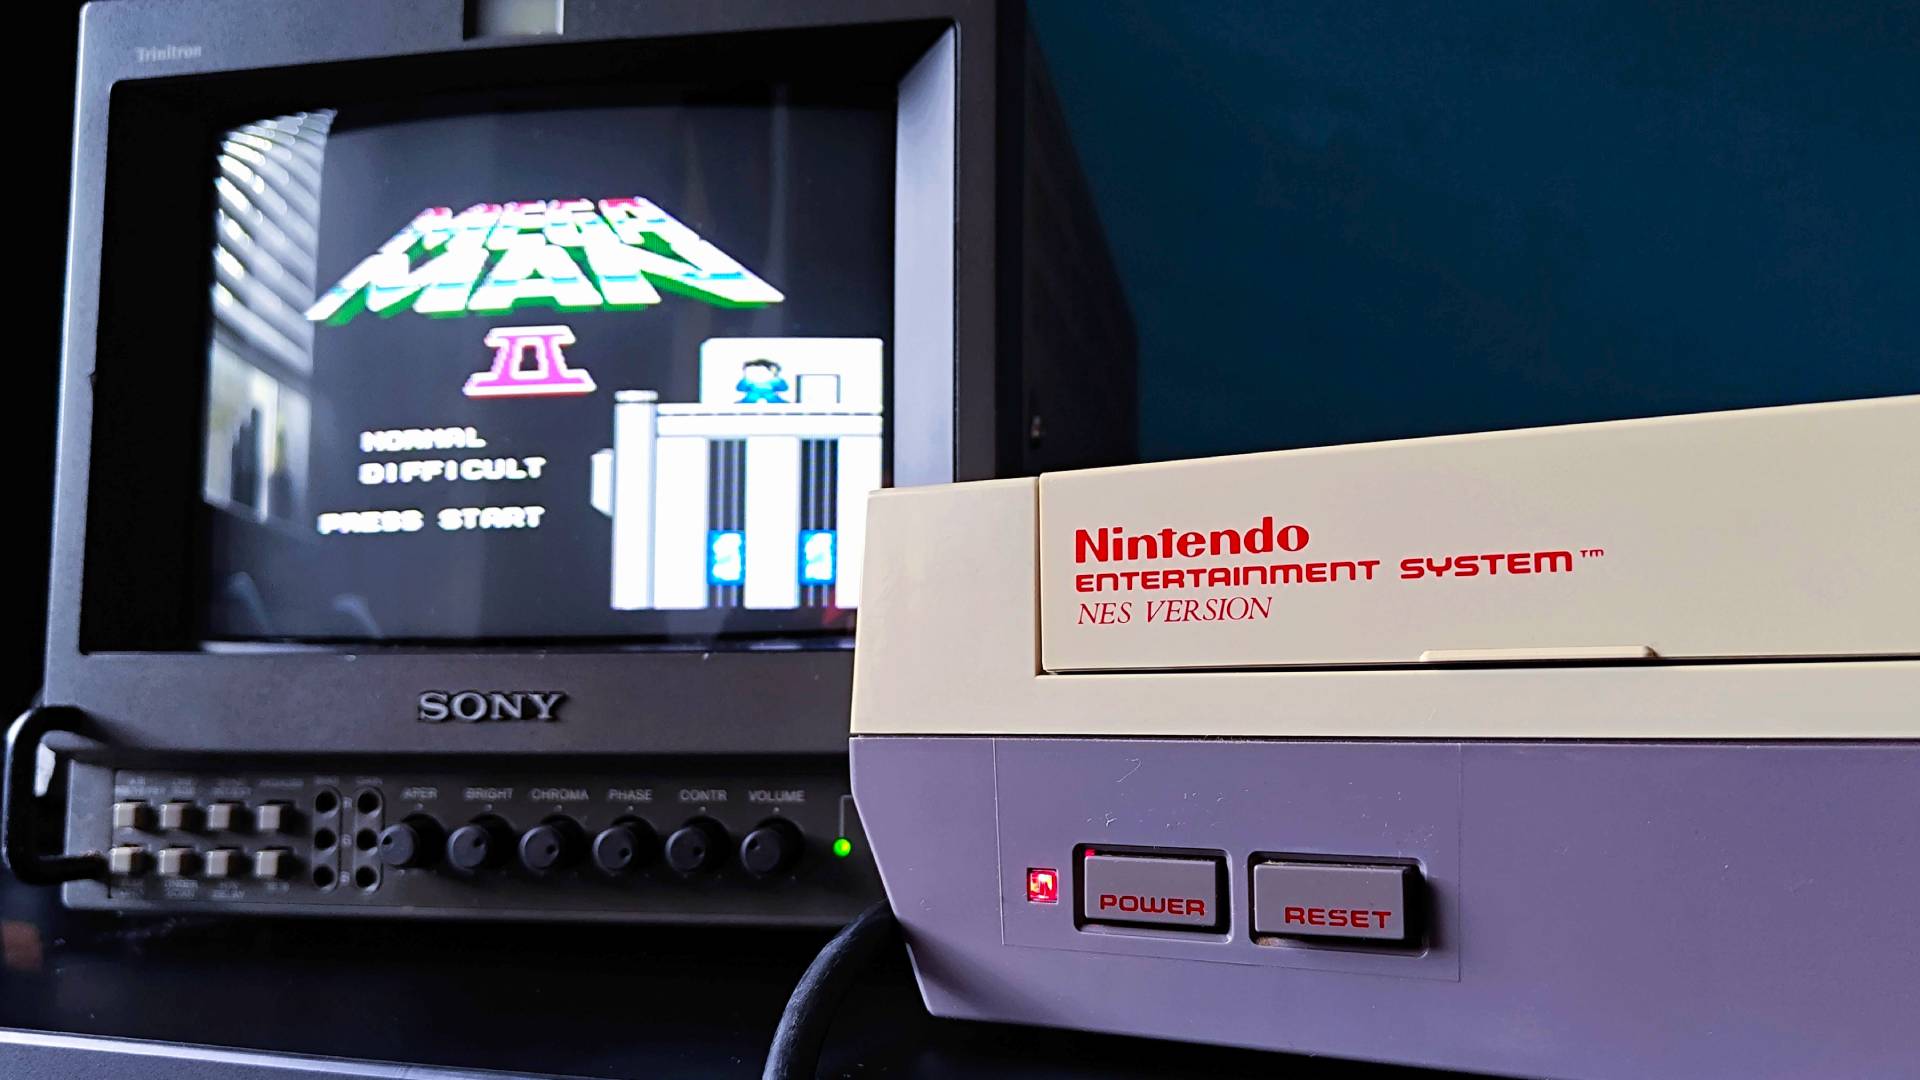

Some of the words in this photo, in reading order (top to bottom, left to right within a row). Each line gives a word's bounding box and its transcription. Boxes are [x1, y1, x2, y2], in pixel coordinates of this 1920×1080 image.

[135, 44, 202, 63] Trinitron
[303, 240, 787, 326] MAN
[360, 426, 487, 452] NORMAL
[358, 456, 547, 485] DIFFICULT
[317, 508, 425, 534] PRESS
[437, 504, 546, 530] START
[1074, 516, 1311, 563] Nintendo
[1075, 560, 1381, 592] ENTERTAINMENT
[1400, 549, 1574, 579] SYSTEM
[1077, 602, 1132, 625] NES
[1144, 596, 1273, 623] VERSION
[417, 691, 566, 722] SONY
[464, 788, 514, 800] BRIGHT
[531, 788, 589, 801] CHROMA
[609, 789, 652, 802] PHASE
[680, 789, 728, 802] CONTR
[748, 790, 805, 803] VOLUME
[1099, 894, 1206, 917] POWER
[1284, 906, 1392, 929] RESET
